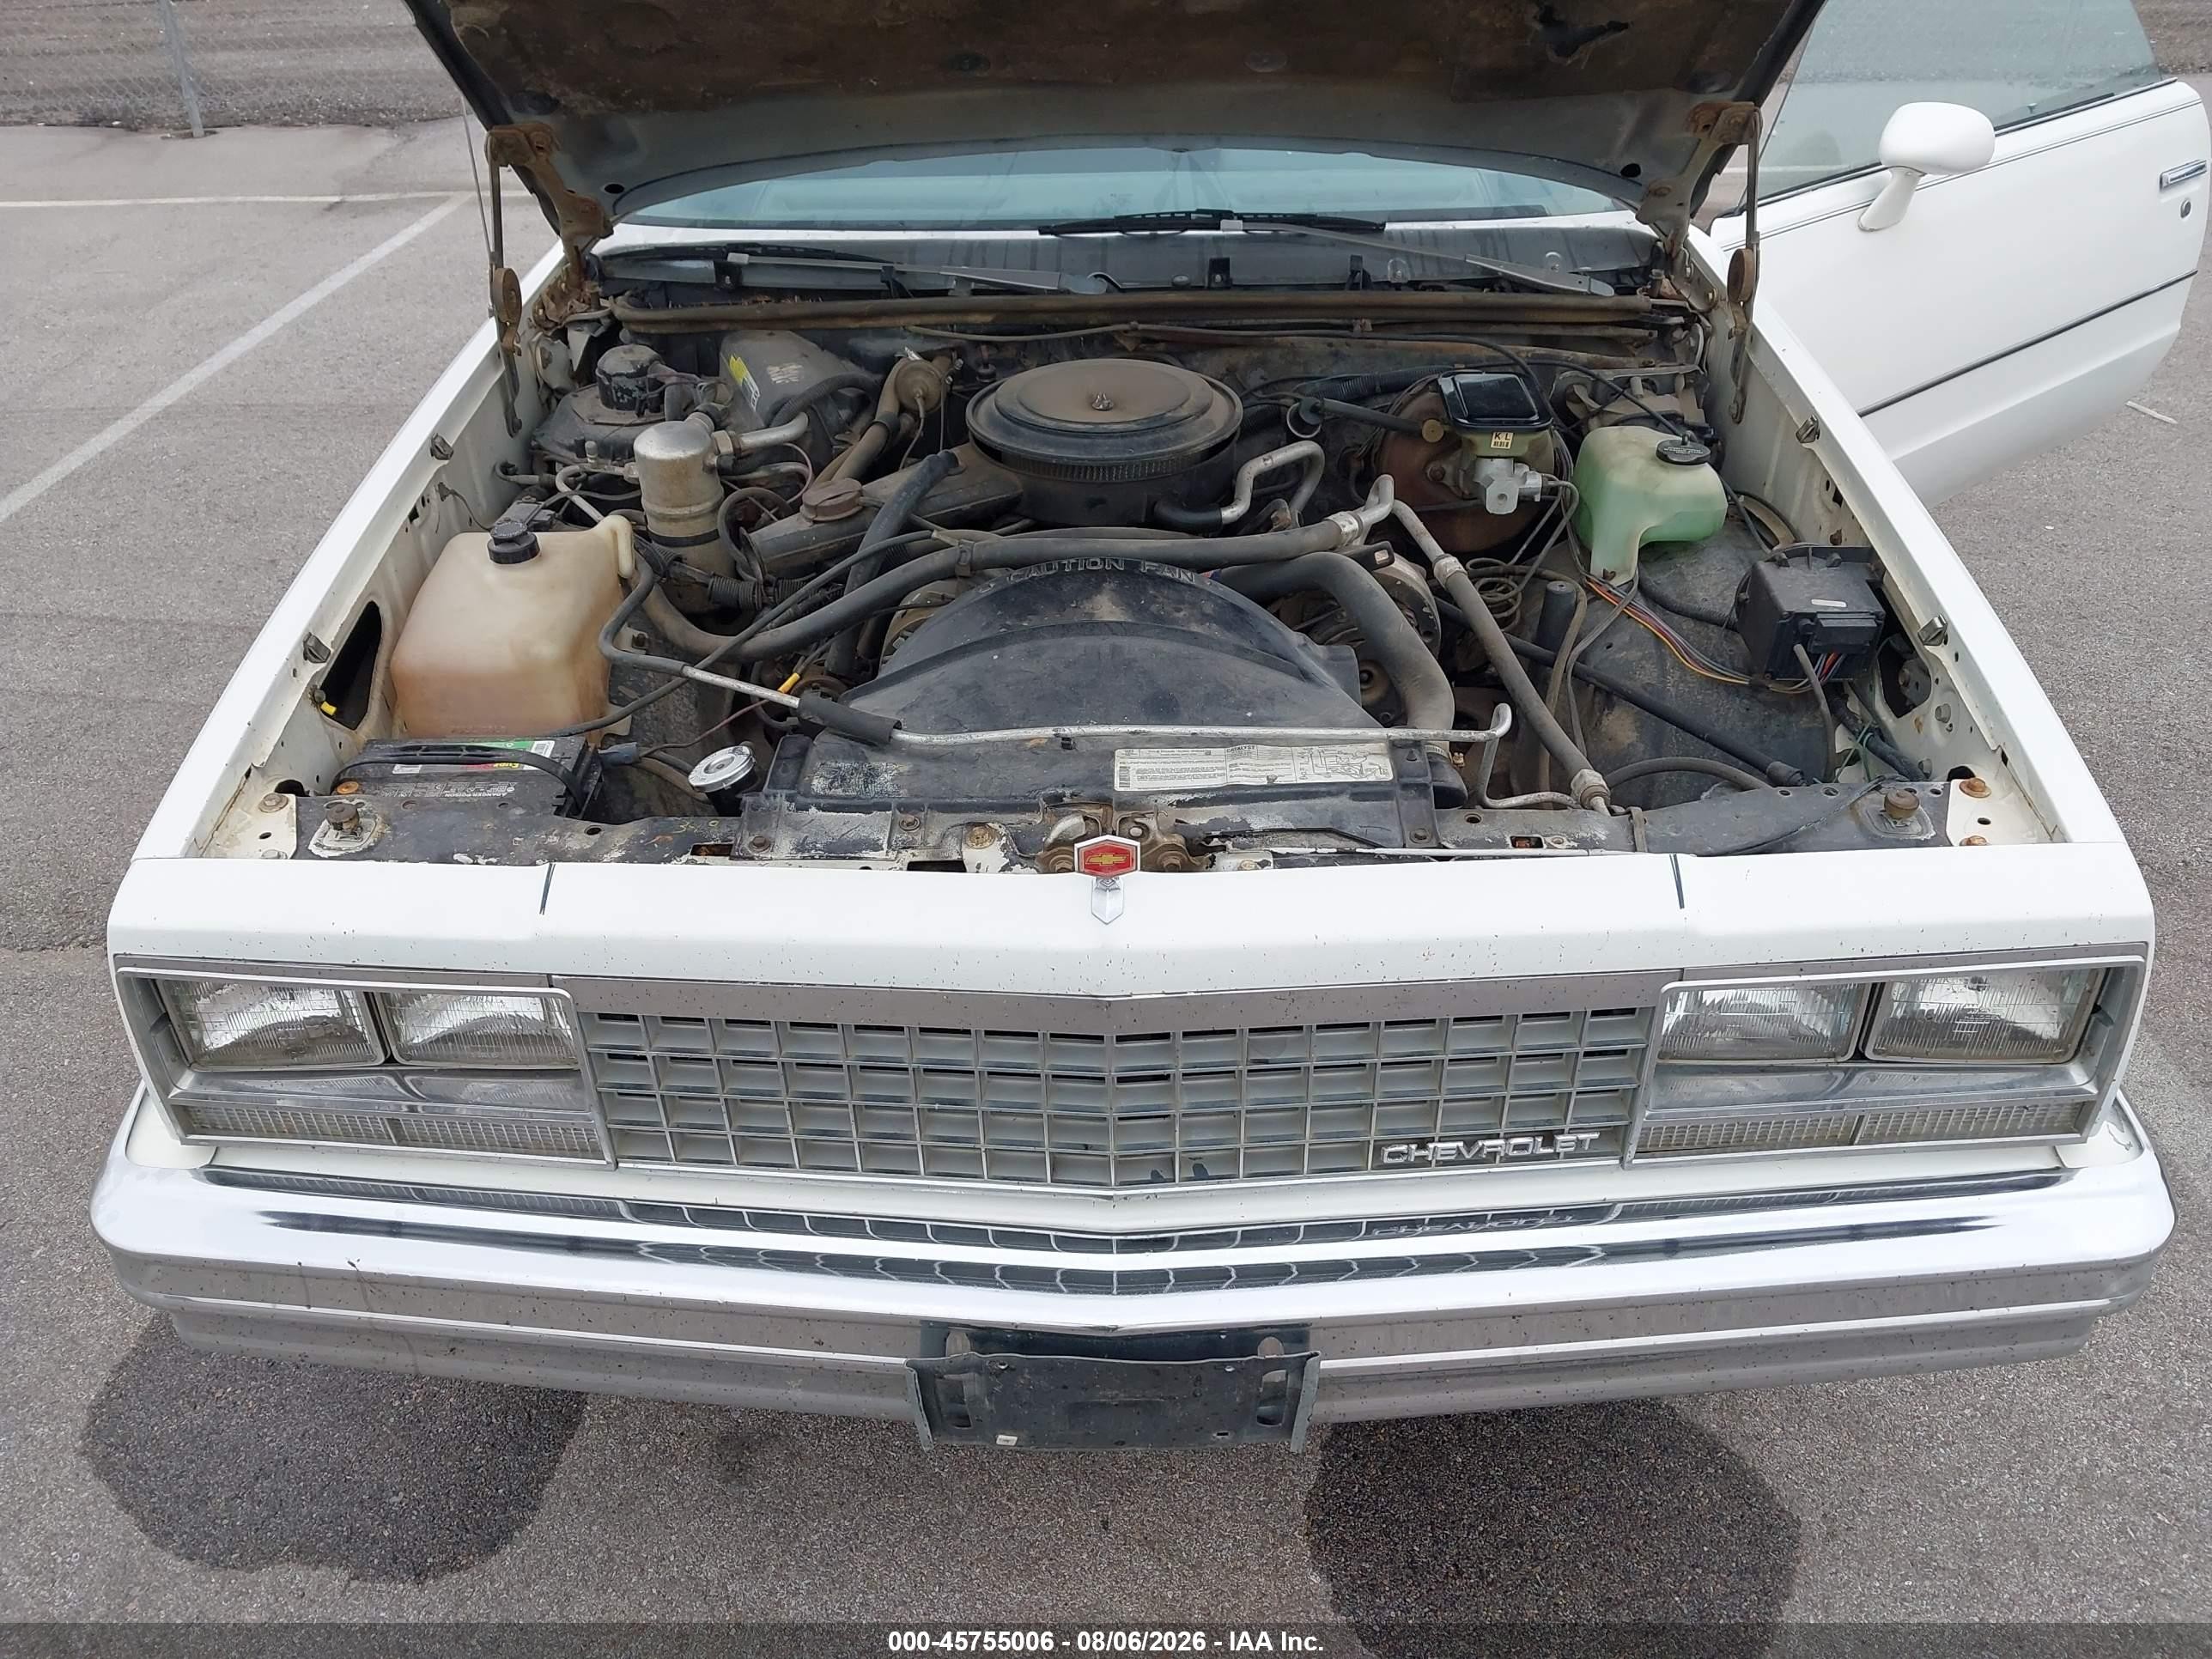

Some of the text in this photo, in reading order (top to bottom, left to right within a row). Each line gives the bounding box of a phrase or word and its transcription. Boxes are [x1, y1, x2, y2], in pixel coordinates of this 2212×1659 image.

[1006, 557, 1197, 585] CAUTION FAN
[1226, 744, 1255, 753] CATALYST
[1381, 1132, 1601, 1164] CHEVROLET
